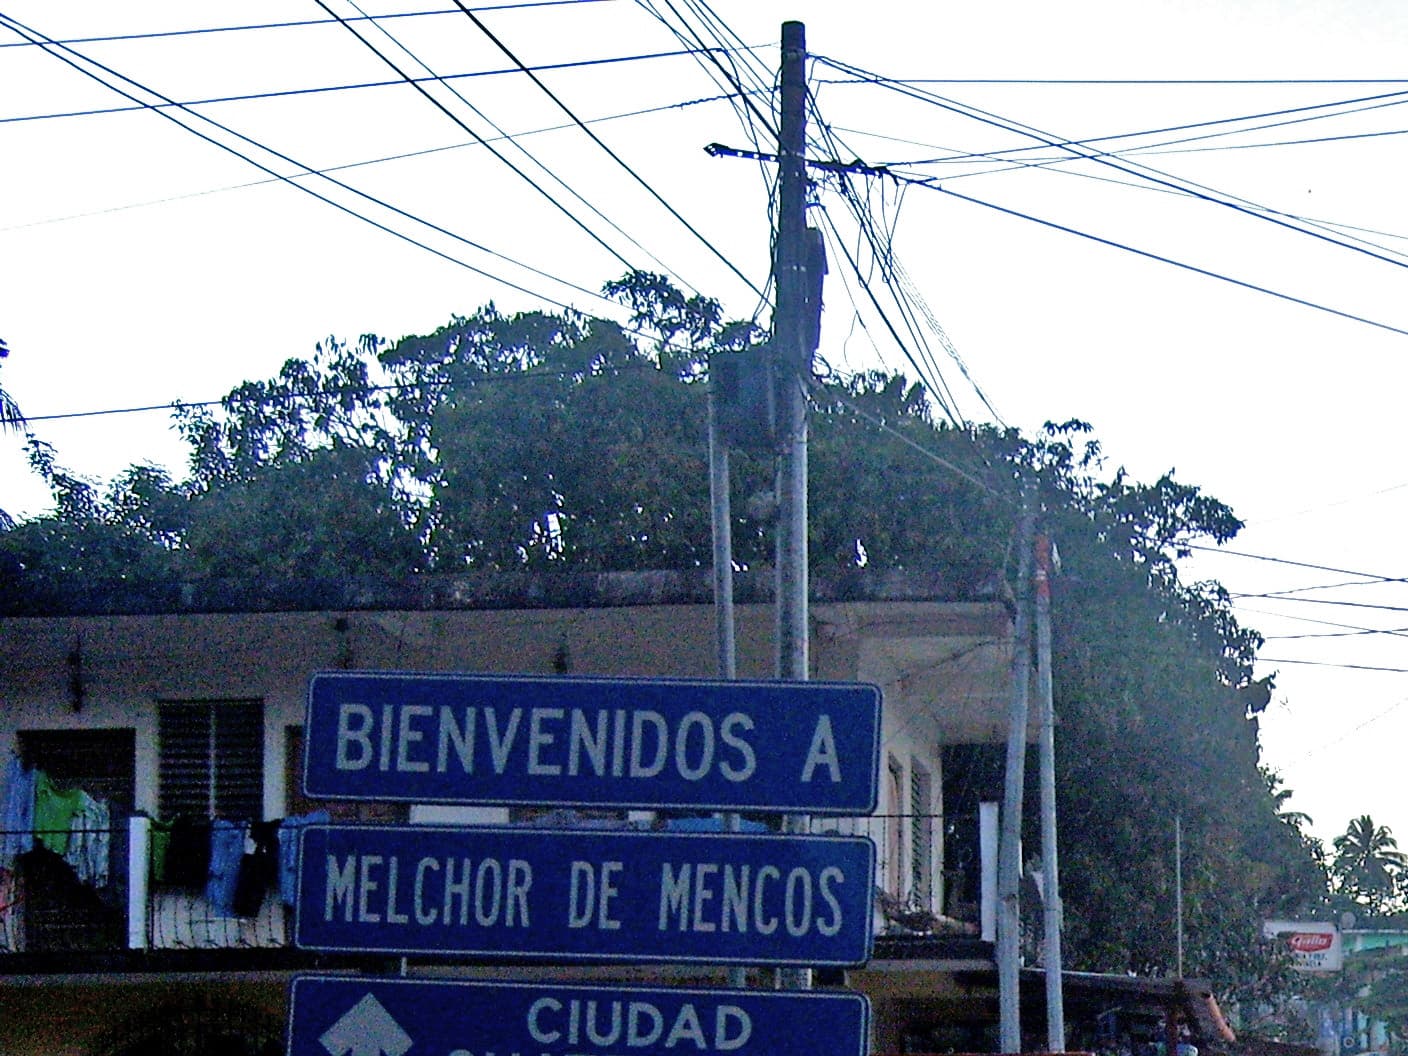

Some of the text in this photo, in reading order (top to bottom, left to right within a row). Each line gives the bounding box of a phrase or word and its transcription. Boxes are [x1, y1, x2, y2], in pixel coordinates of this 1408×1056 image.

[334, 703, 842, 783] BIENVENIDOS A
[324, 853, 844, 937] MELCHOR DE MENCOS
[526, 997, 754, 1052] CIUDAD
